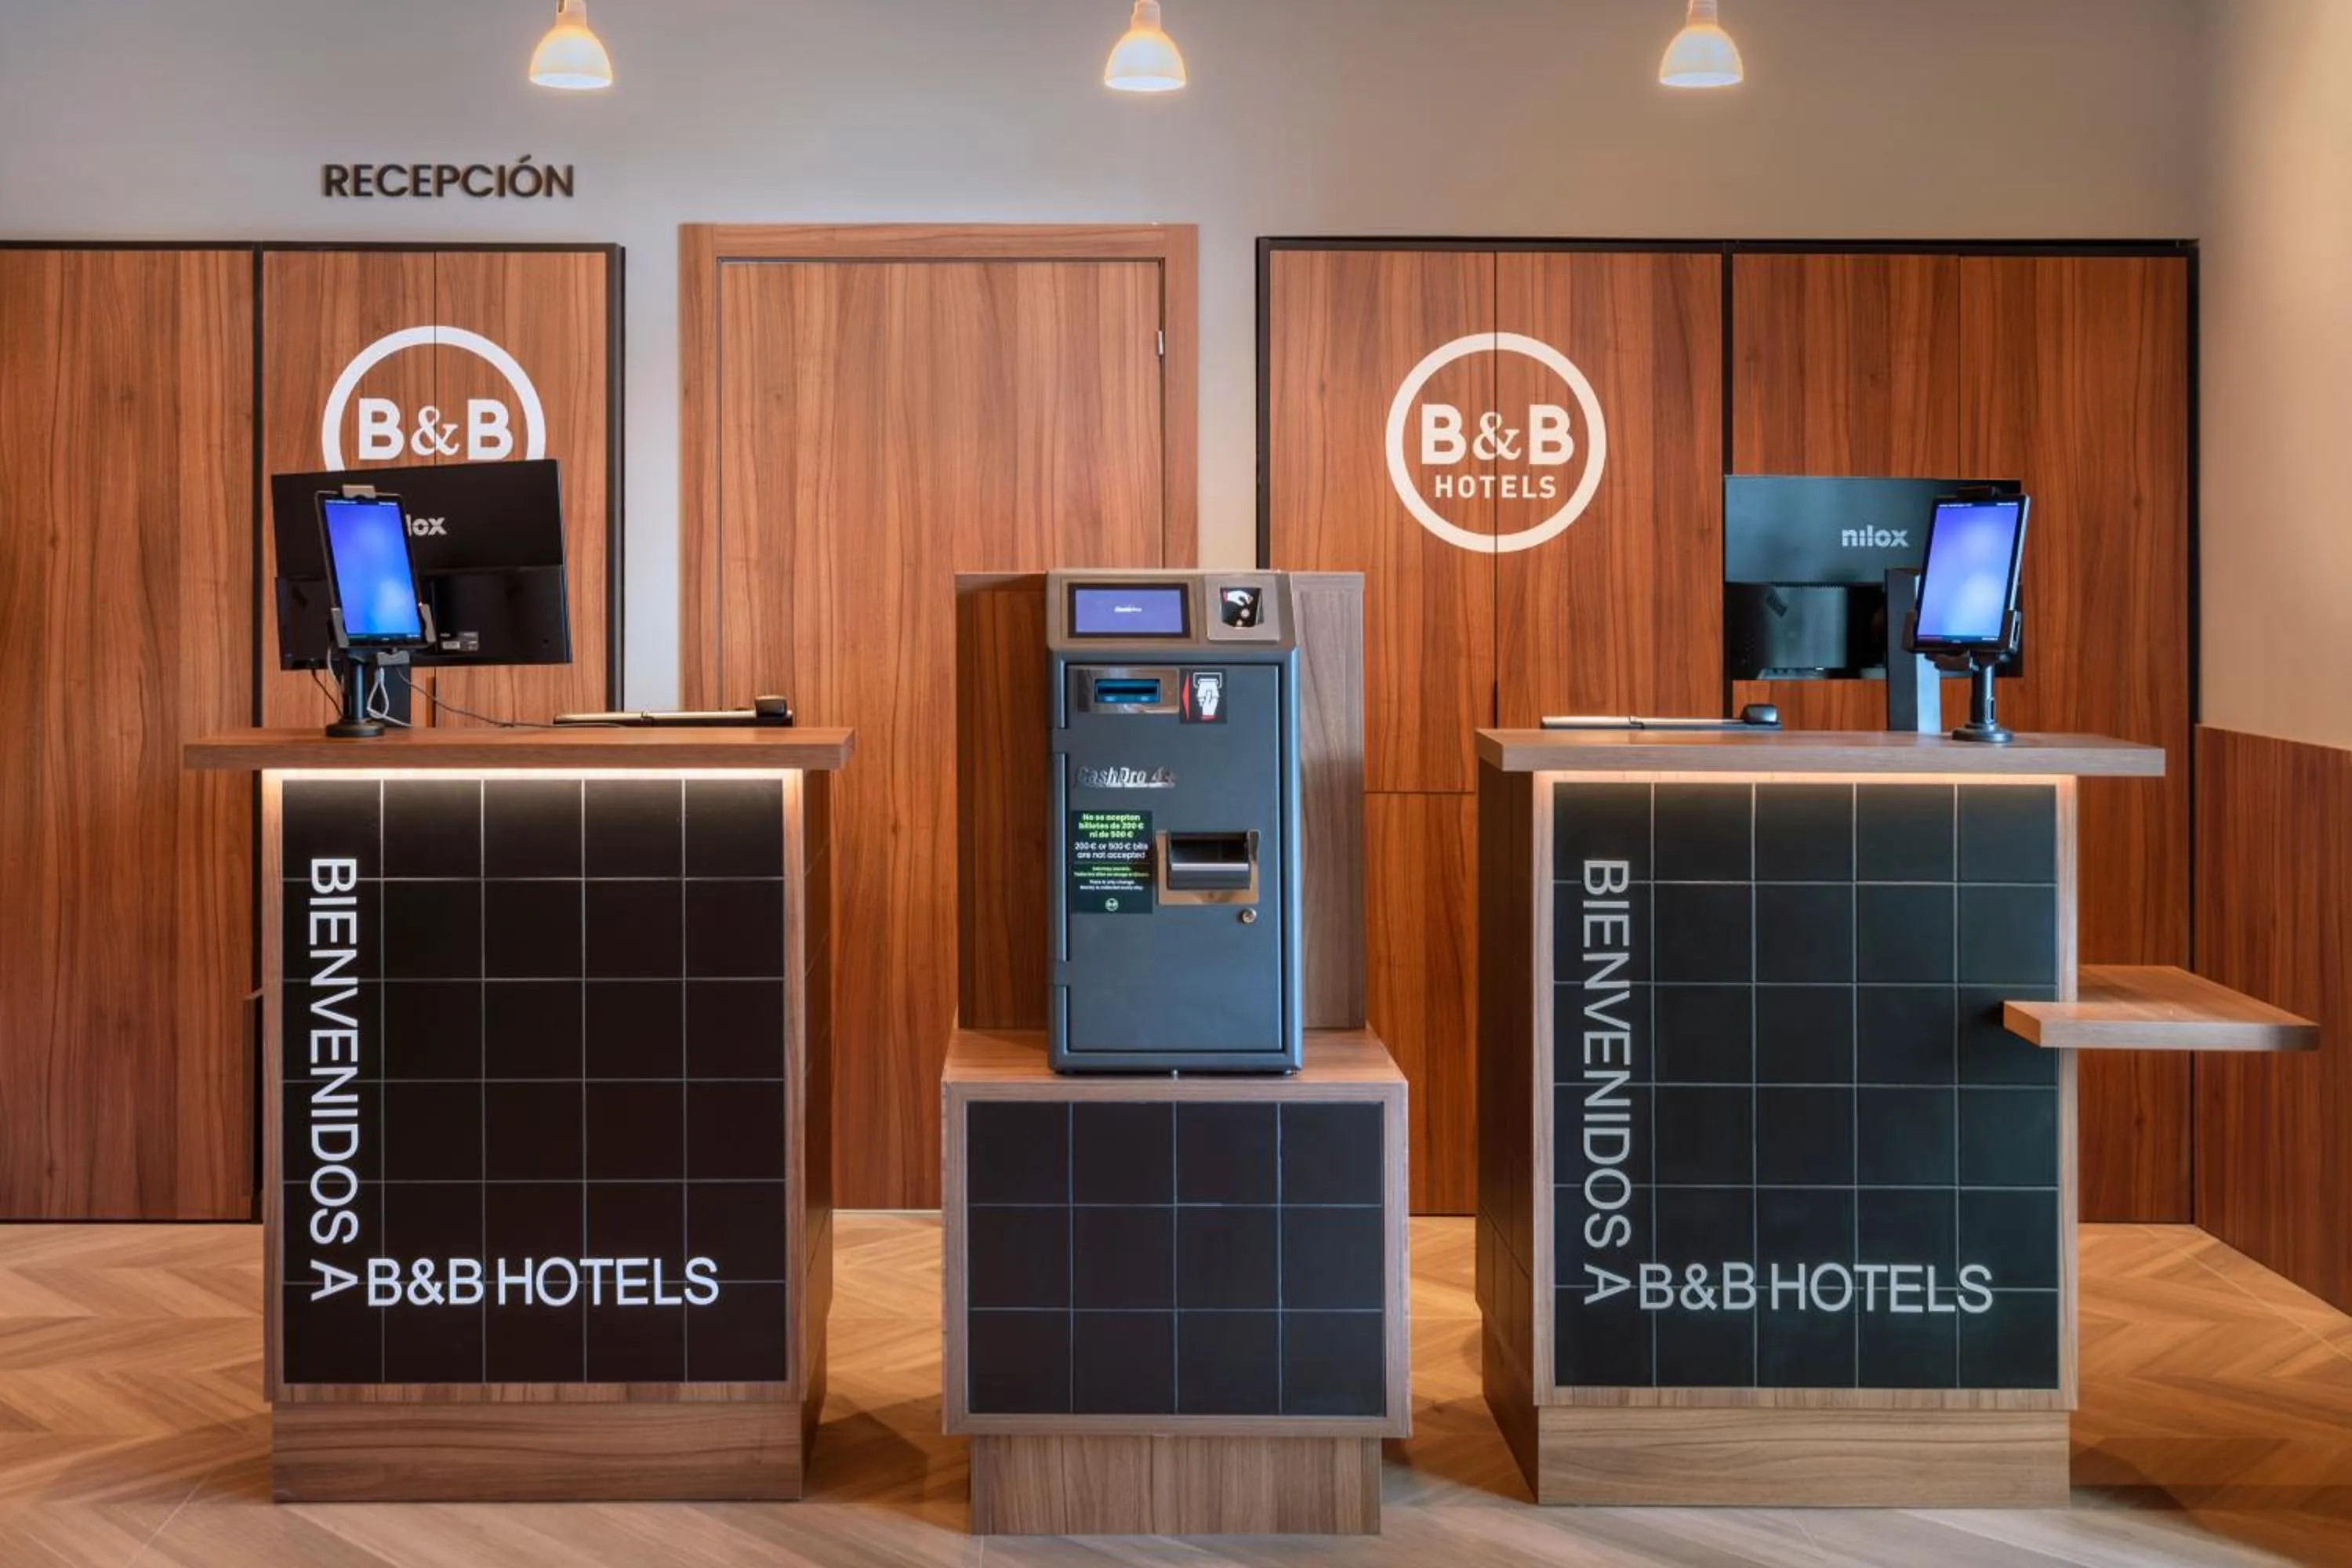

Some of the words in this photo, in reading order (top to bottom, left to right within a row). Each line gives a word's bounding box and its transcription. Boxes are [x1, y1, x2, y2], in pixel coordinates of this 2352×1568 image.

[322, 154, 574, 197] RECEPCIÓN
[358, 397, 514, 460] B&B
[1421, 404, 1575, 465] B&B
[1436, 475, 1556, 499] HOTELS
[405, 514, 448, 536] lox
[1842, 525, 1909, 548] nilox
[310, 858, 359, 1245] BIENVENIDOS
[1583, 859, 1632, 1248] BIENVENIDOS
[310, 1259, 359, 1301] A
[368, 1258, 484, 1307] B&B
[498, 1257, 720, 1307] HOTELS
[1584, 1263, 1632, 1305] A
[1639, 1262, 1757, 1311] B&B
[1771, 1263, 1994, 1313] HOTELS
